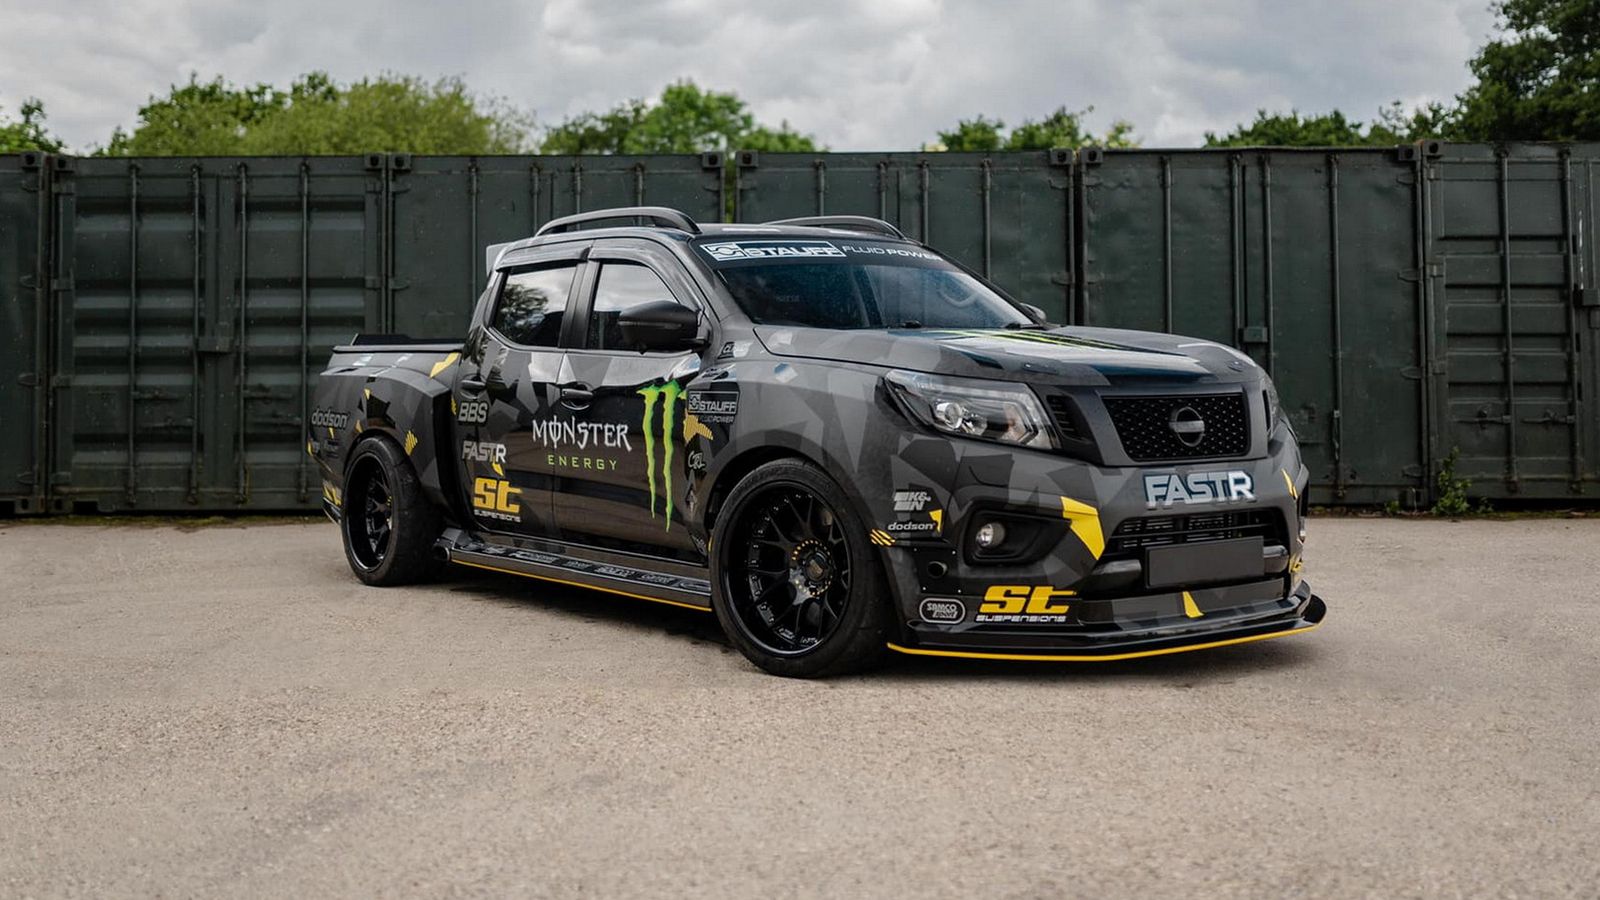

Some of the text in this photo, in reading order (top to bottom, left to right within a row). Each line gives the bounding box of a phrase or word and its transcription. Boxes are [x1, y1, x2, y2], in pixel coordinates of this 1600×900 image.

[458, 402, 488, 423] BBS
[700, 401, 736, 412] STAUFF
[311, 408, 347, 428] dodson
[533, 415, 632, 452] MONSTER
[462, 440, 507, 463] FASTR
[548, 454, 617, 471] ENERGY
[1144, 470, 1255, 507] FASTR
[887, 521, 934, 531] dodson
[975, 614, 1067, 623] SUSPENSIONS
